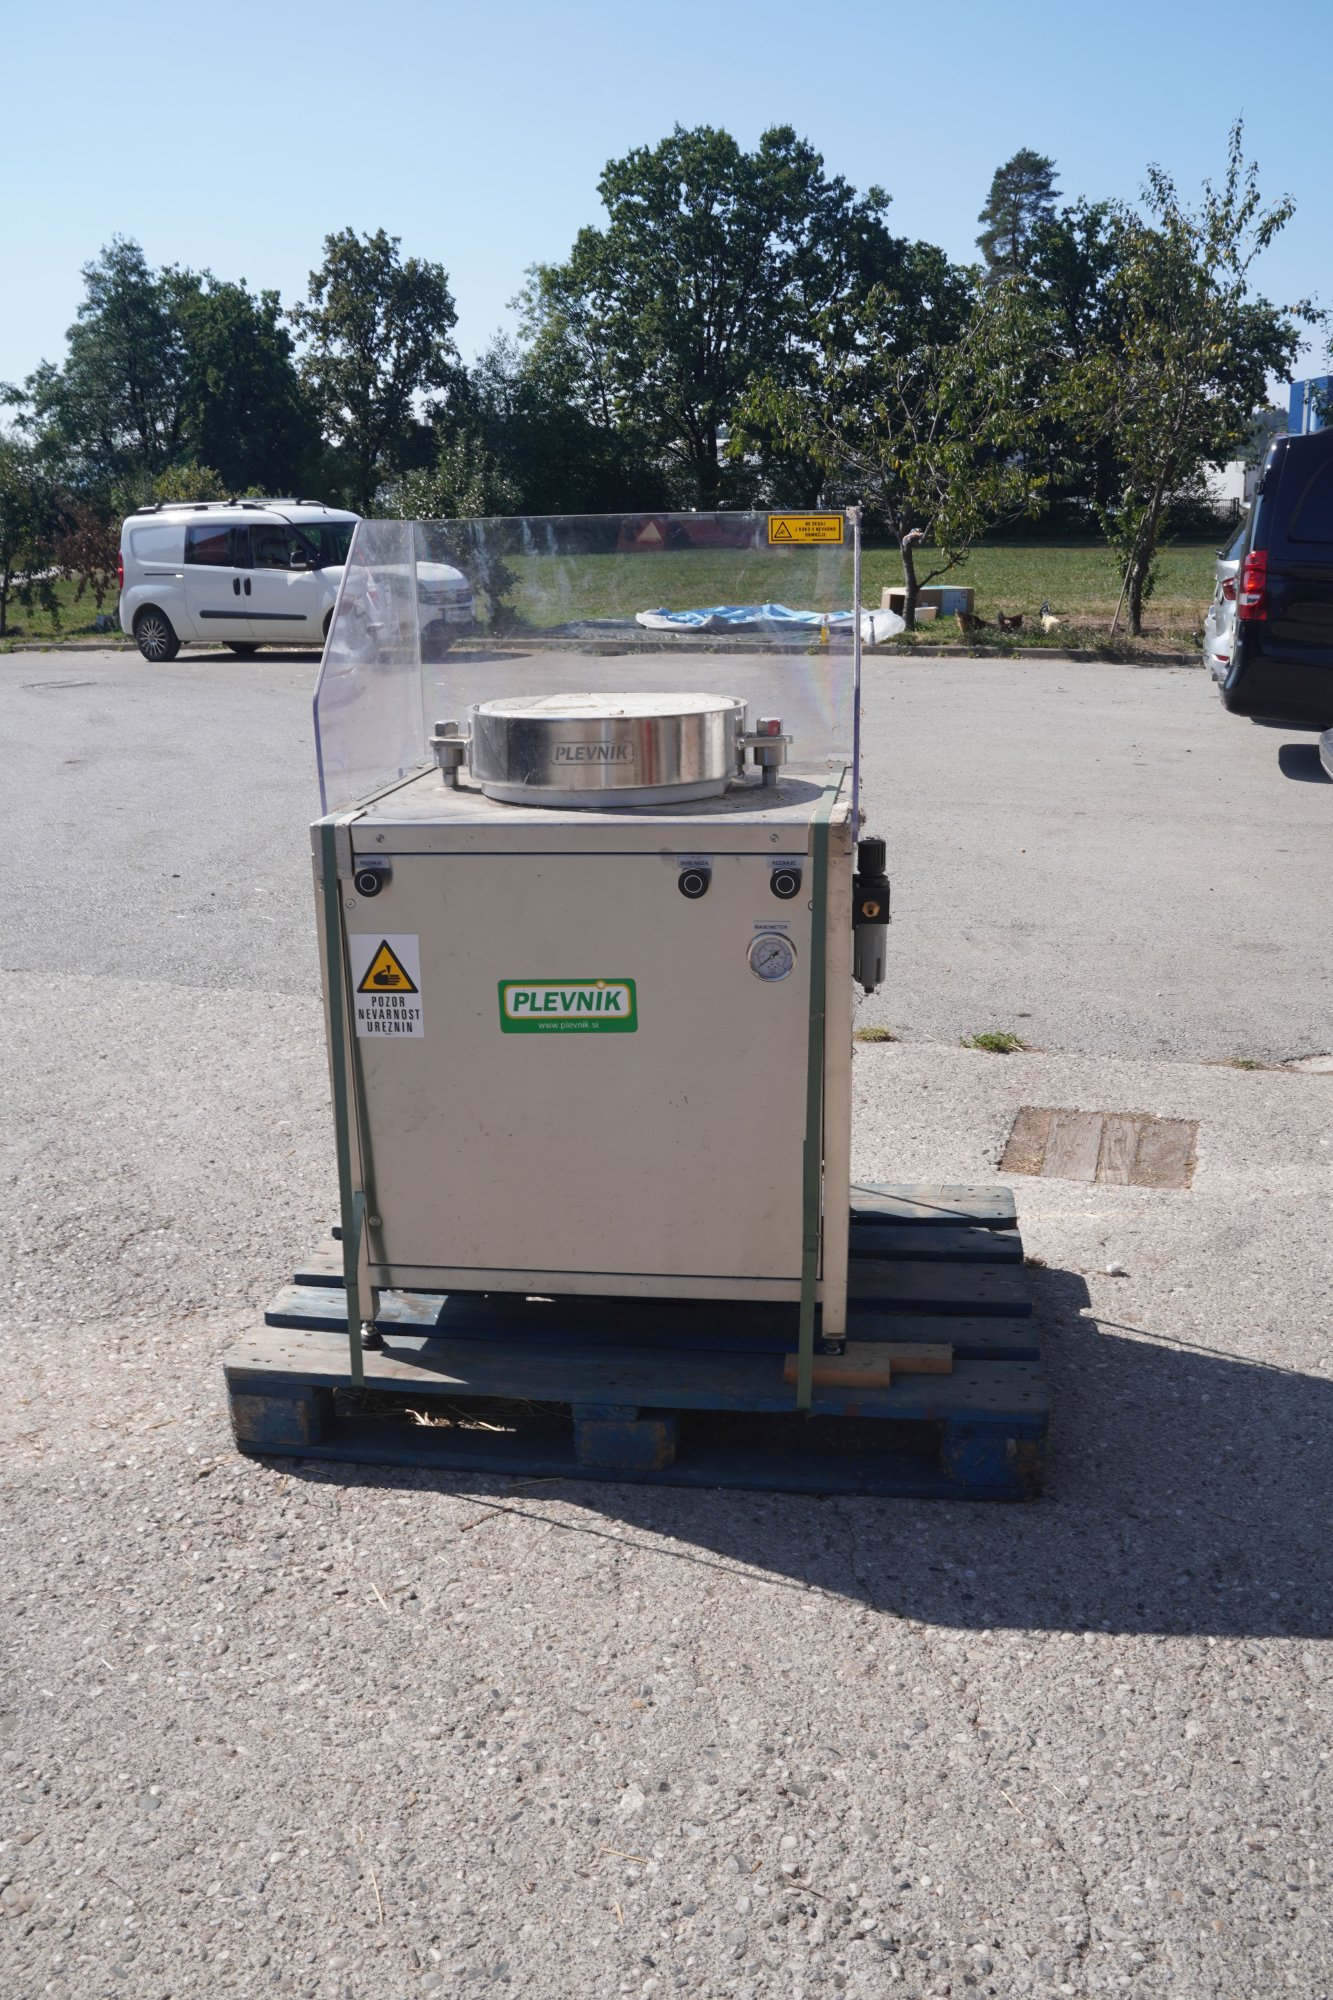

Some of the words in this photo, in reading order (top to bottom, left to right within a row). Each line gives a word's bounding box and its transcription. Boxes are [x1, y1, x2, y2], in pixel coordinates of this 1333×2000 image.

[555, 744, 628, 761] PLEVNIK
[371, 996, 405, 1007] POZOR
[513, 991, 622, 1012] PLEVNIK
[358, 1008, 420, 1020] NEVARNOST
[367, 1021, 413, 1033] UREZNIN
[538, 1021, 599, 1029] www.plevnik.si
